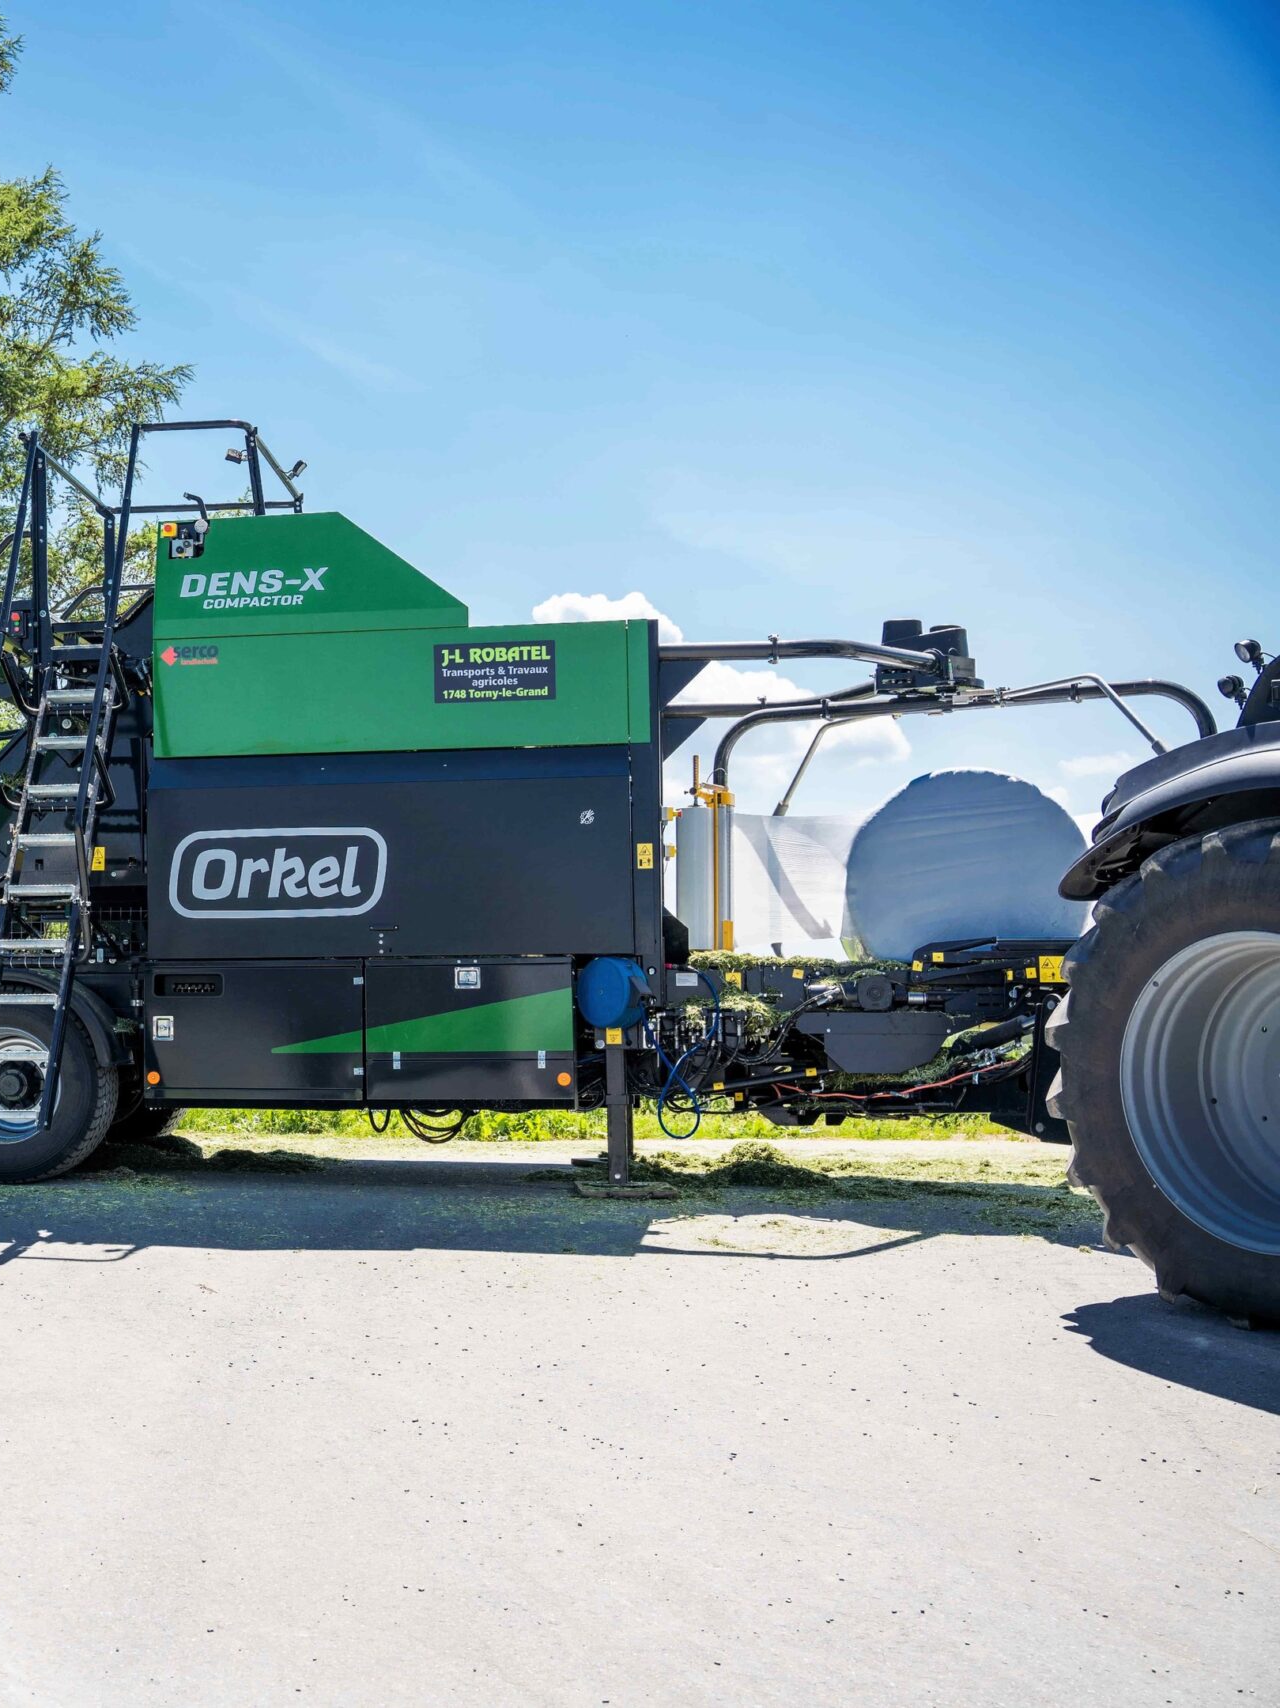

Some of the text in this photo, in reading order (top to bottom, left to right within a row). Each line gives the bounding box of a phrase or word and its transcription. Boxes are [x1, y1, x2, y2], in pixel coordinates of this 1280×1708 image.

[180, 567, 328, 597] DENS-X
[203, 595, 303, 609] COMPACTOR
[173, 645, 218, 658] serco
[441, 645, 551, 667] J-L ROBATEL
[442, 666, 548, 678] Transports & Travaux
[472, 677, 518, 688] agricoles
[443, 686, 548, 699] 1748 Torny-le-Grand
[192, 846, 361, 900] Orkel
